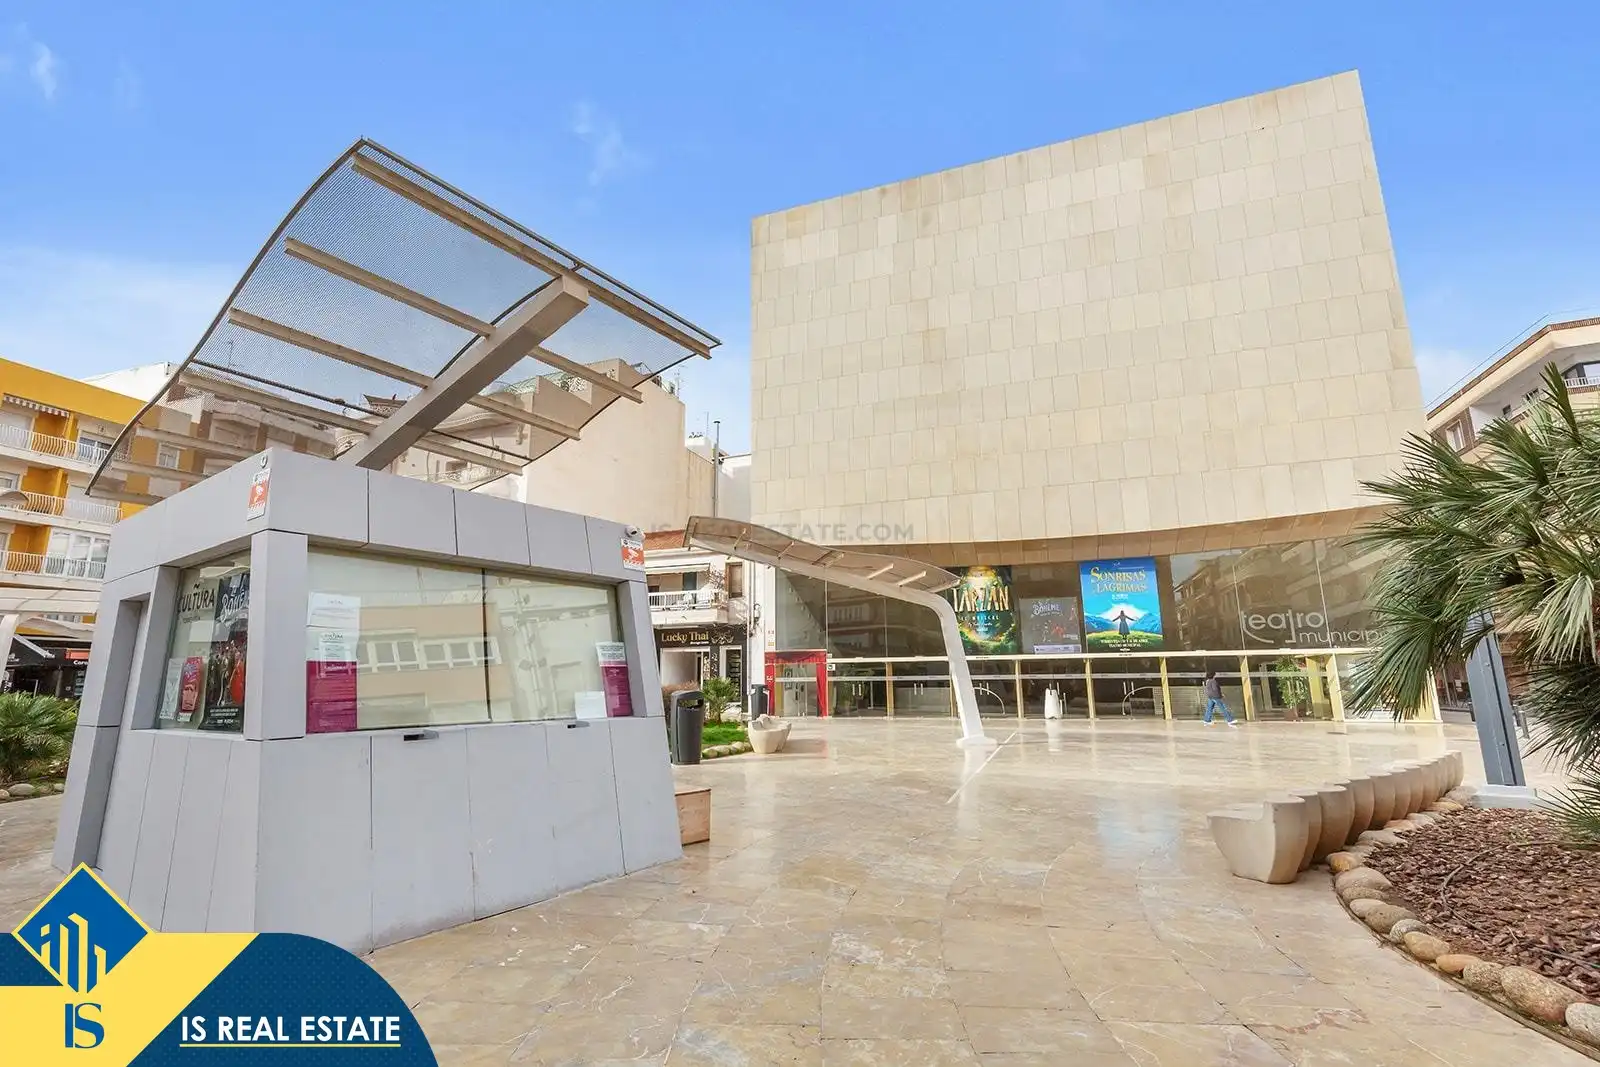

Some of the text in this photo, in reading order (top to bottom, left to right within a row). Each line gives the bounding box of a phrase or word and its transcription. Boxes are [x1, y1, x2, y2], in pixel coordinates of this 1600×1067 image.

[1090, 566, 1148, 580] SONRISAS
[1241, 609, 1325, 644] teatro
[662, 631, 709, 644] Lucky Thai
[1299, 629, 1392, 644] municip
